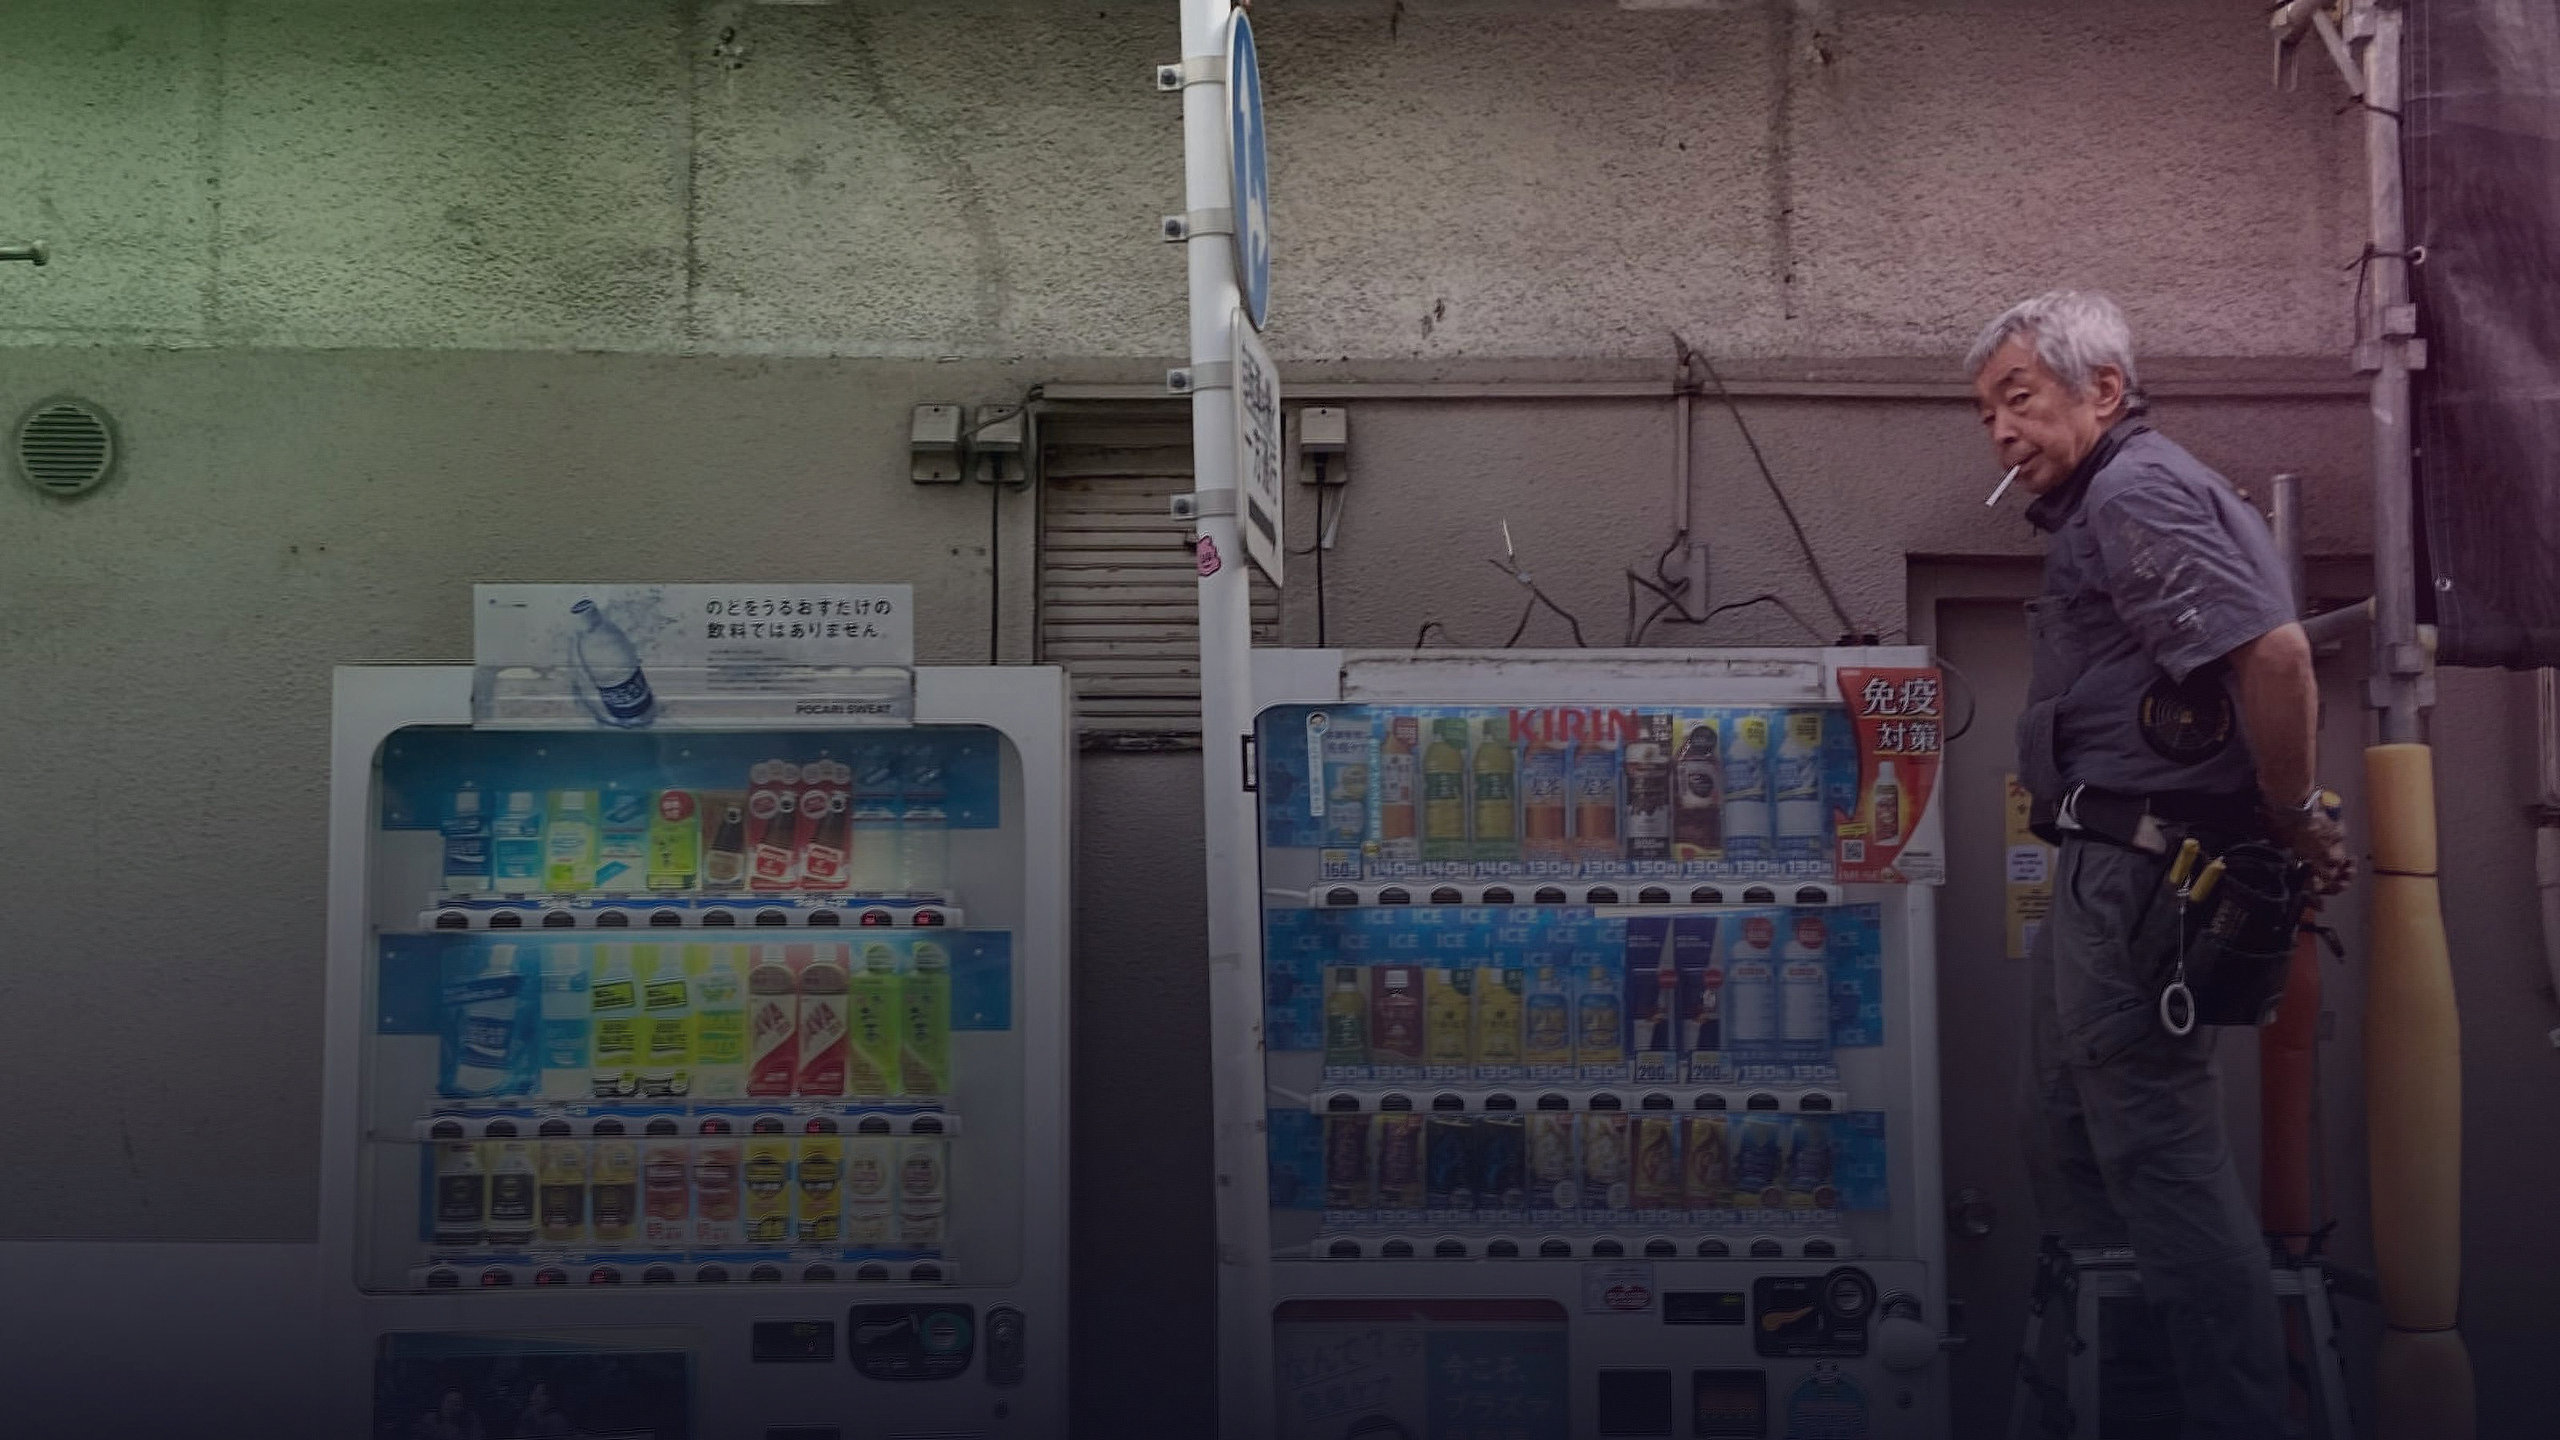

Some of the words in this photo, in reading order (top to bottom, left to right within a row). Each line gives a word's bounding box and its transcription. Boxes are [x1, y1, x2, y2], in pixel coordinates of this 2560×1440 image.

[1861, 677, 1939, 717] 免疫
[795, 704, 844, 715] POCARI
[847, 704, 891, 715] SWEAT
[1509, 708, 1637, 742] KIRIN
[1875, 722, 1940, 753] 対策
[1411, 908, 1442, 923] ICE
[1460, 908, 1490, 923] ICE
[1389, 933, 1420, 949] ICE
[1437, 933, 1468, 949] ICE
